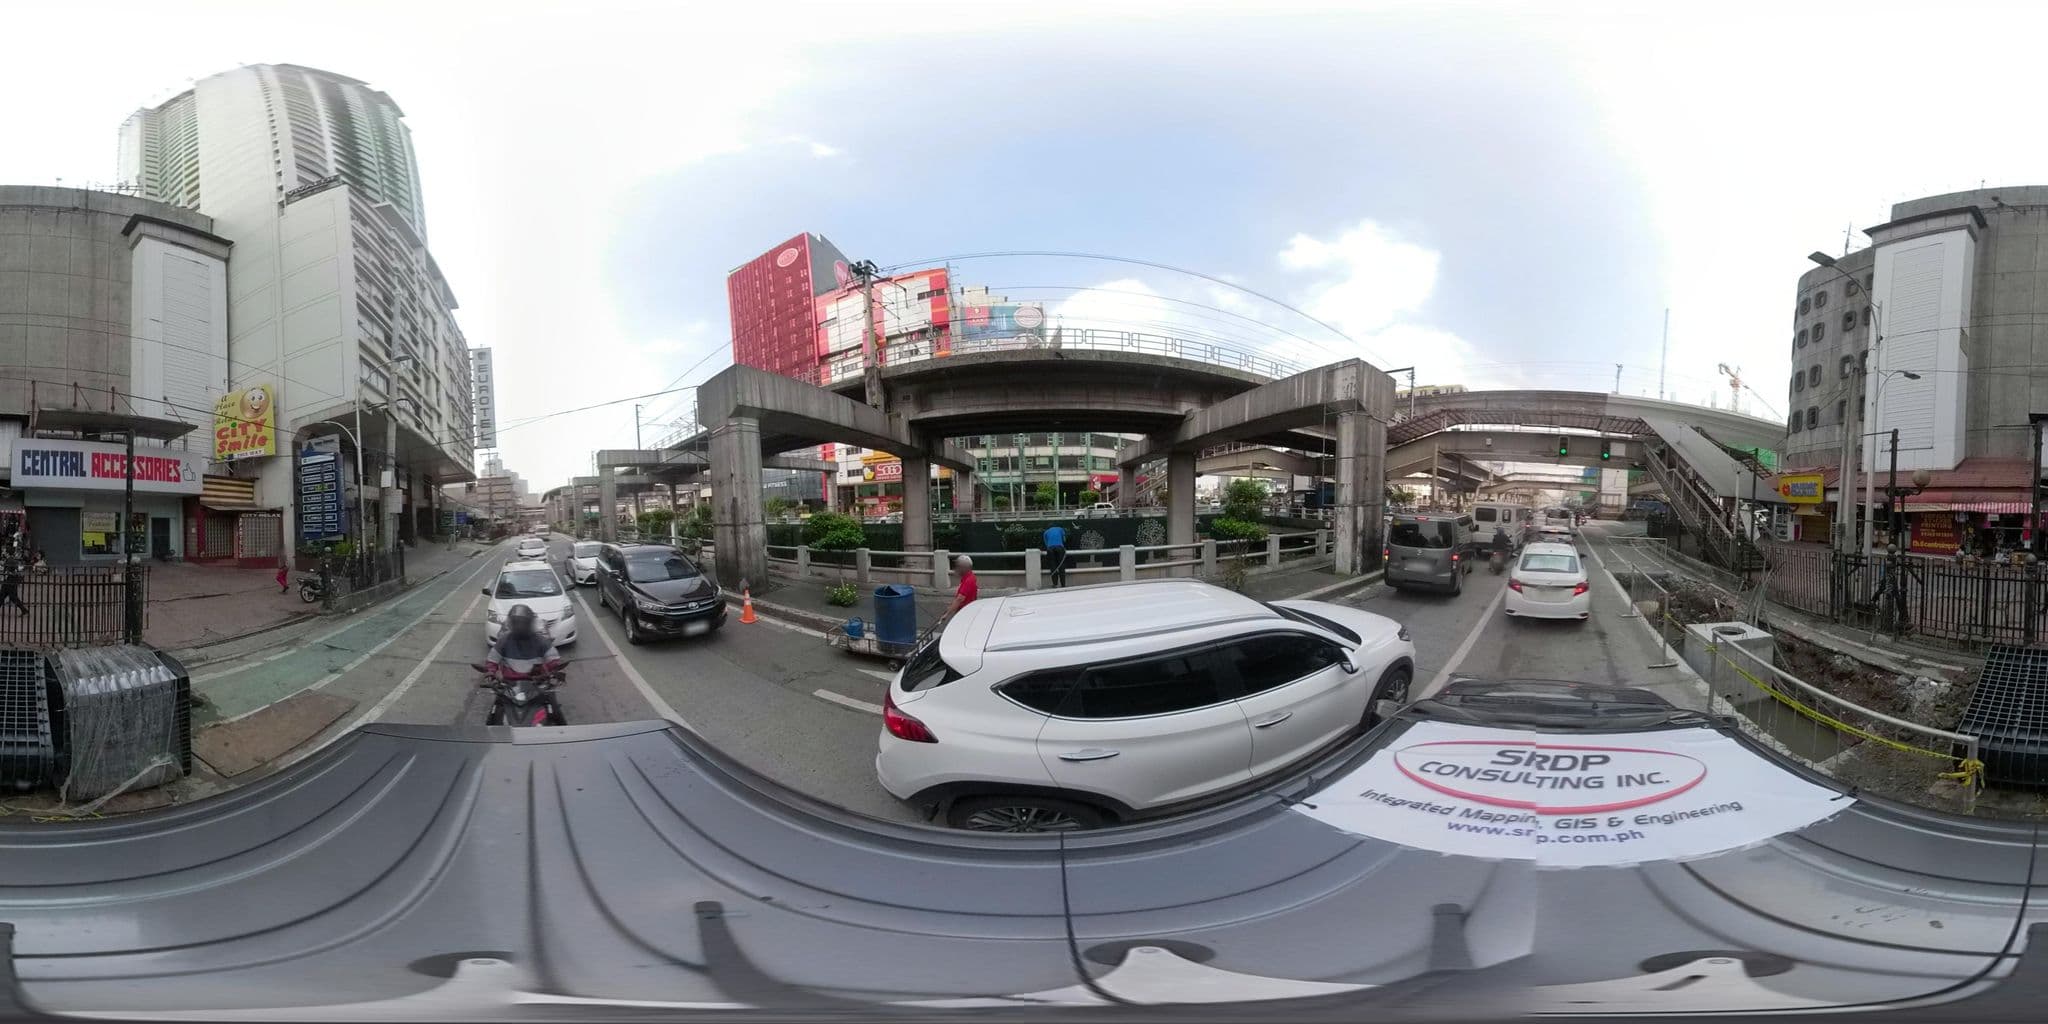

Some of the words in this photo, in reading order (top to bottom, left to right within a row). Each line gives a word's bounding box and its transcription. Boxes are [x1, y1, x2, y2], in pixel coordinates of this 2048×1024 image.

[478, 364, 492, 441] EUROTEL
[216, 433, 267, 454] Smile
[21, 449, 87, 477] CENTRAL
[1418, 760, 1604, 790] CONSULTING
[1615, 771, 1670, 788] INC.
[1490, 748, 1611, 773] SRDP
[1359, 788, 1457, 816] Integrated
[1554, 817, 1598, 829] GIS
[1606, 816, 1625, 828] &
[1633, 800, 1744, 826] Engineering
